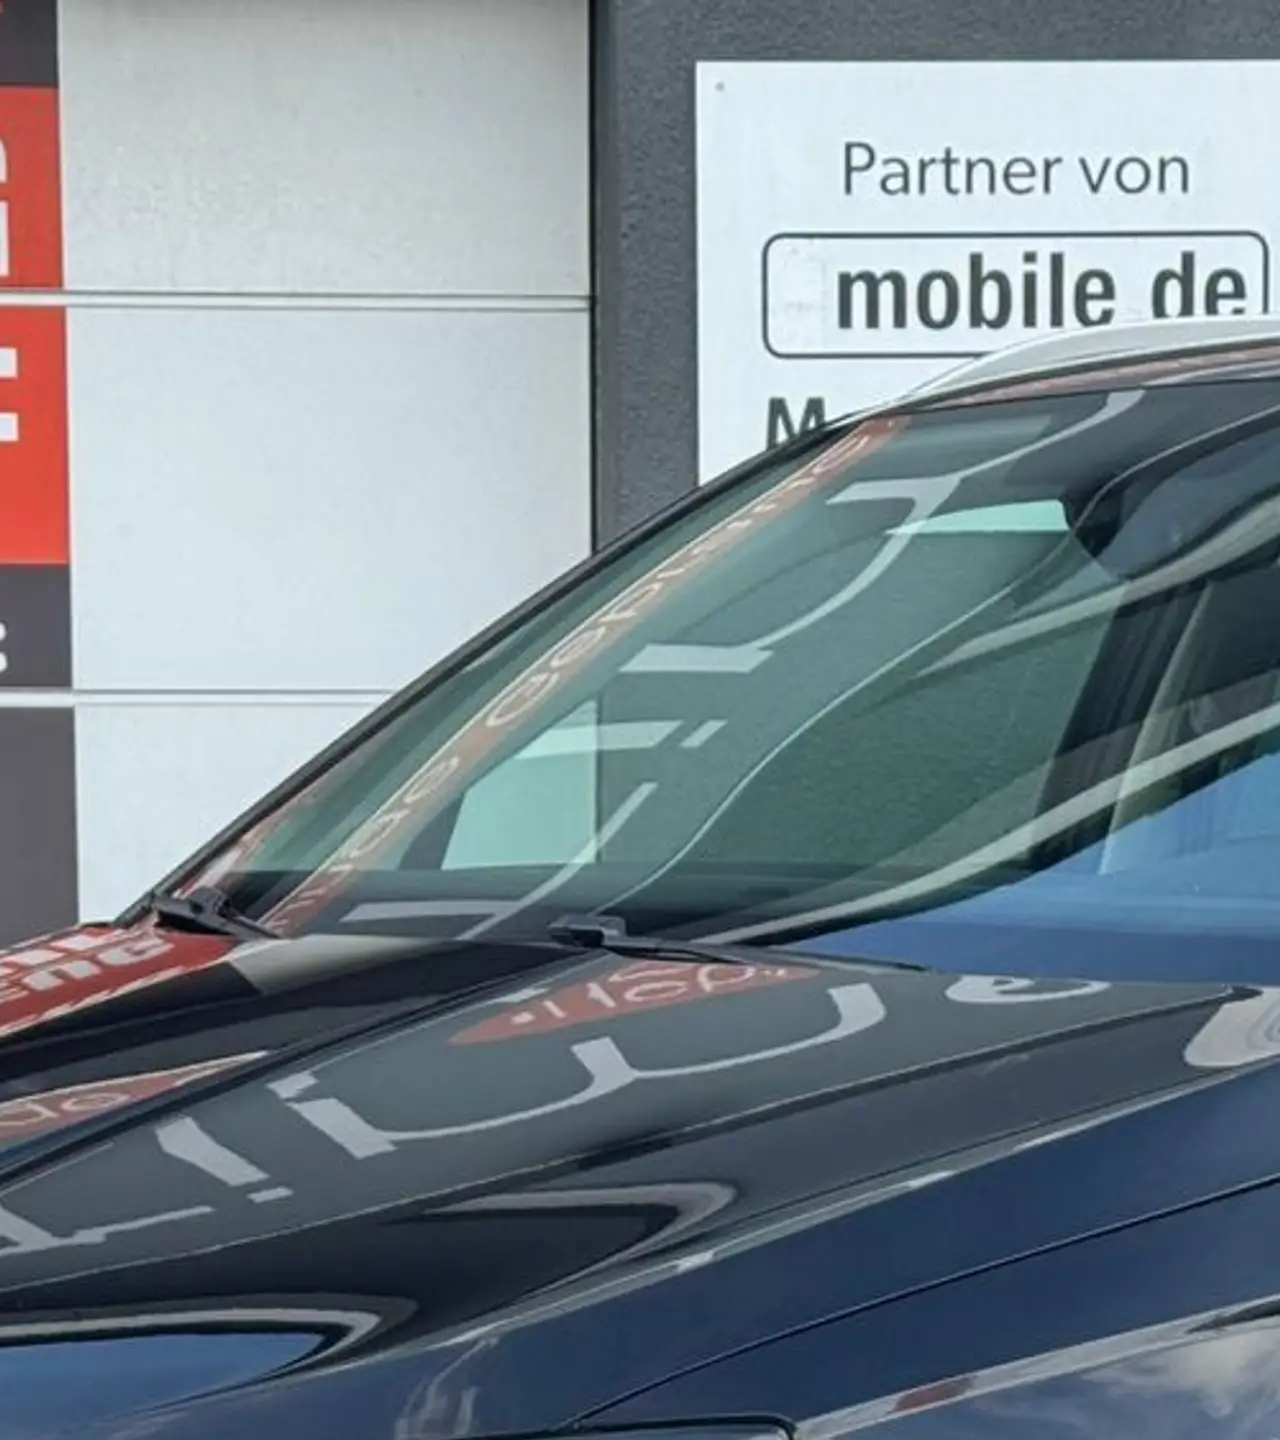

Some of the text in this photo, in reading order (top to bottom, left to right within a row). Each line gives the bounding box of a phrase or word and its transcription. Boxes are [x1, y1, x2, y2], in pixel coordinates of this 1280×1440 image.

[843, 141, 1190, 196] Partner von
[767, 397, 826, 450] M
